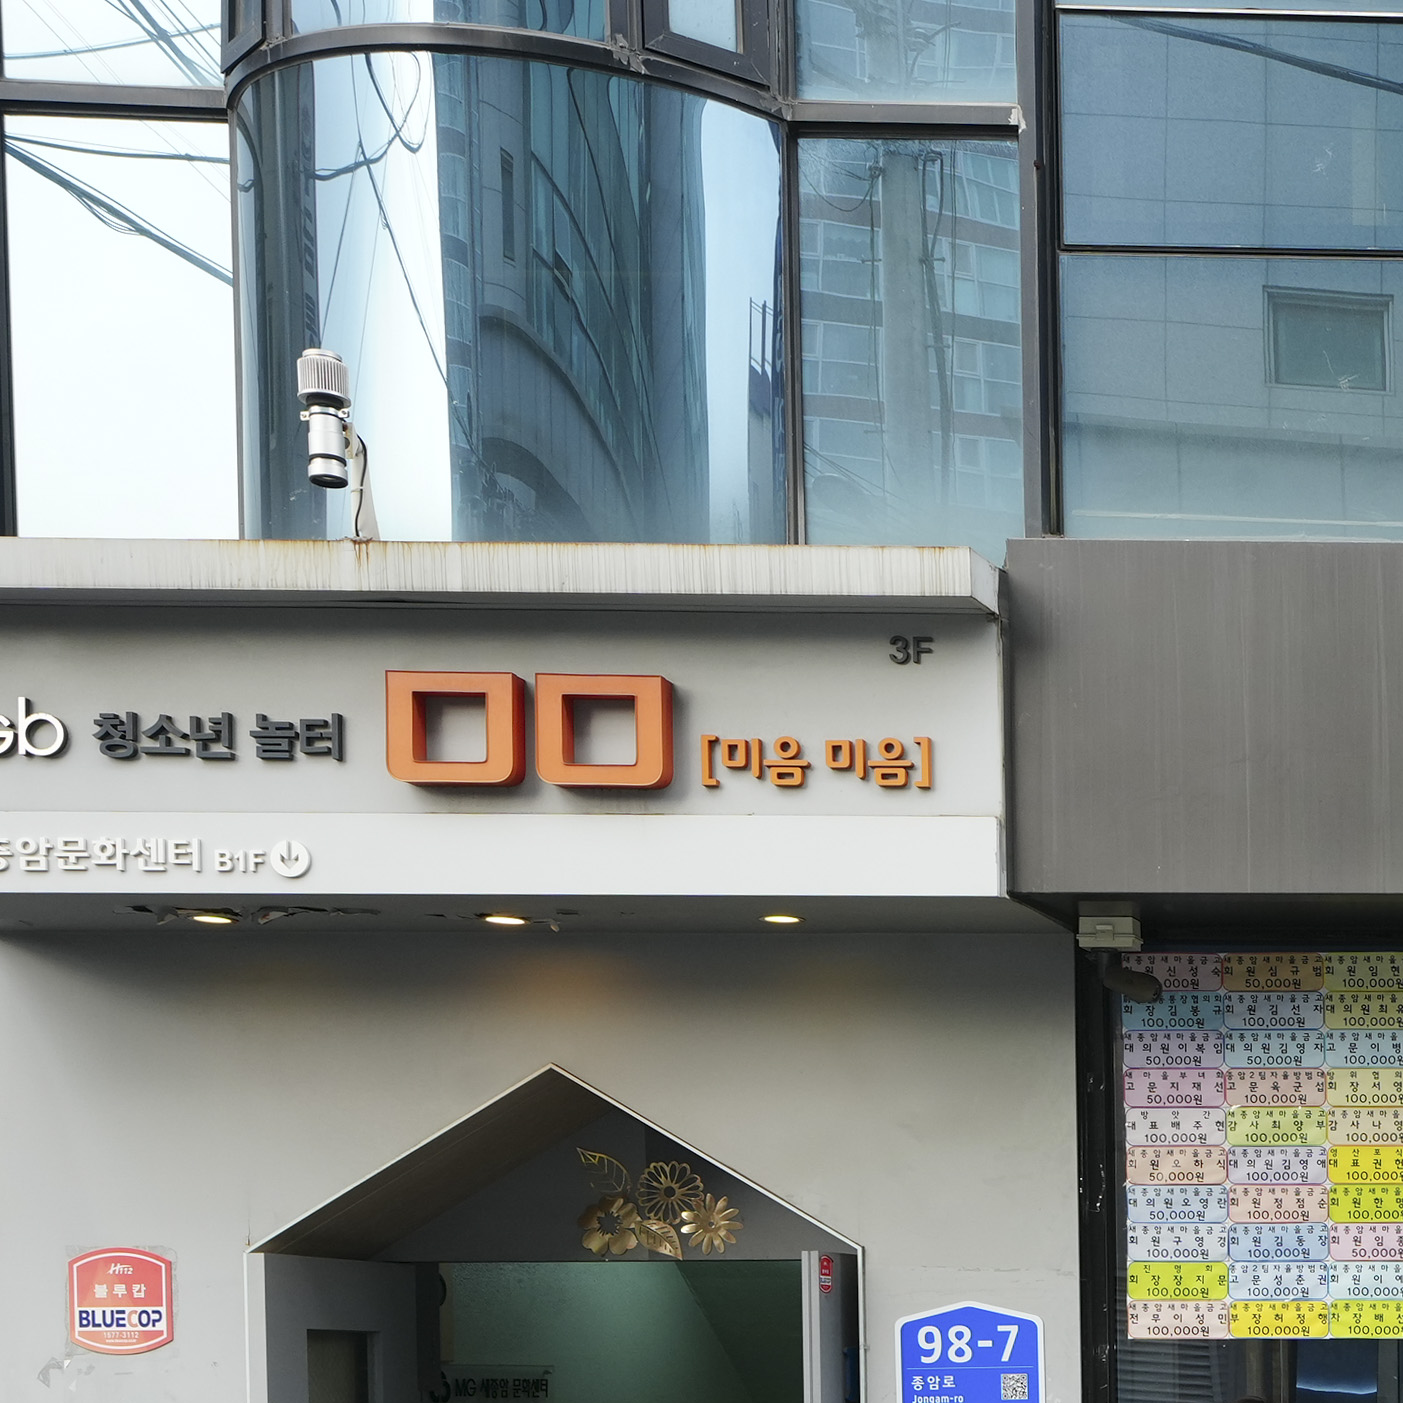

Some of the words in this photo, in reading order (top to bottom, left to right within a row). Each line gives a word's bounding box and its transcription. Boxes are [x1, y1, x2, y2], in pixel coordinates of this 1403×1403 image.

[888, 635, 934, 665] 3F
[93, 711, 236, 760] 청소년
[249, 712, 344, 763] 놀터
[701, 734, 811, 787] [미음
[825, 736, 932, 789] 미음]
[214, 850, 266, 872] B1F
[1244, 977, 1302, 991] 50,000원
[1140, 1017, 1205, 1030] 100,000원
[1146, 1286, 1210, 1299] 100,000원
[78, 1309, 163, 1329] BLUECOP
[103, 1331, 140, 1339] 1577-3112
[917, 1324, 1020, 1365] 98-7
[455, 1378, 476, 1397] MG
[911, 1375, 956, 1391] 종암로
